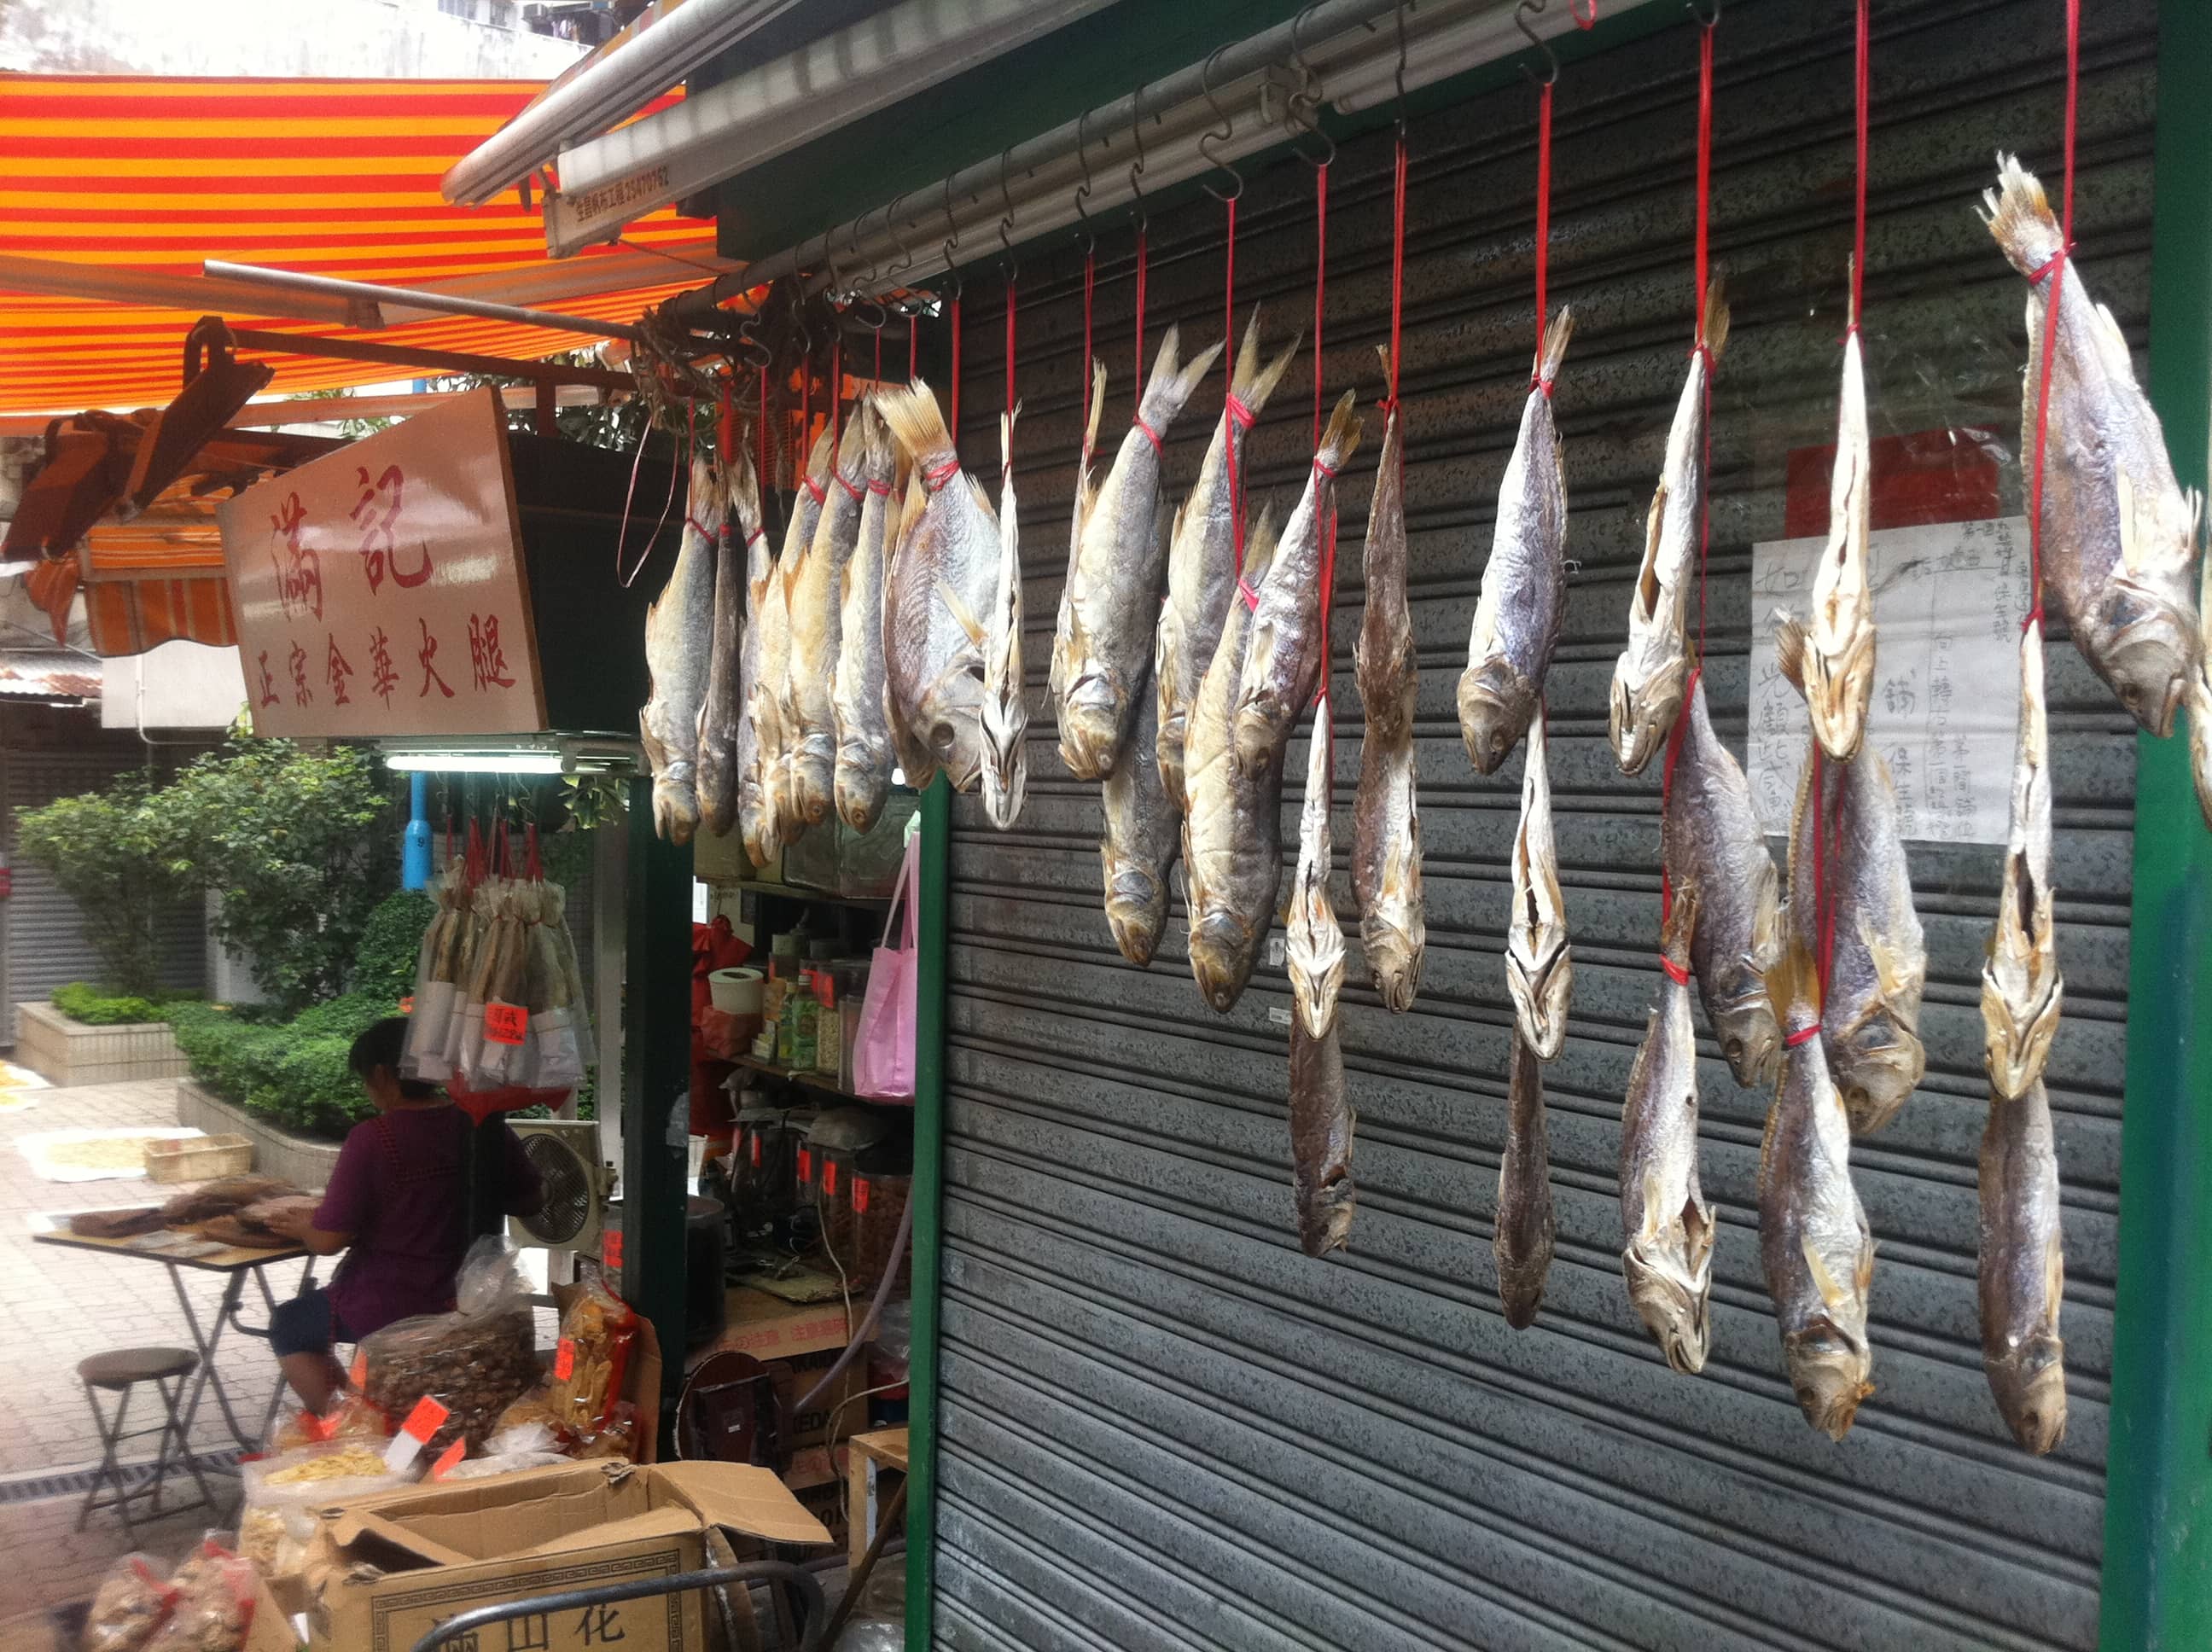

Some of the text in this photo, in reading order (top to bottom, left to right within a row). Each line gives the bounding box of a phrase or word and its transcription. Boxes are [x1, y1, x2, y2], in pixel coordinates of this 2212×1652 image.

[270, 464, 434, 623] 滿記
[258, 613, 517, 711] 正宗金華火腿
